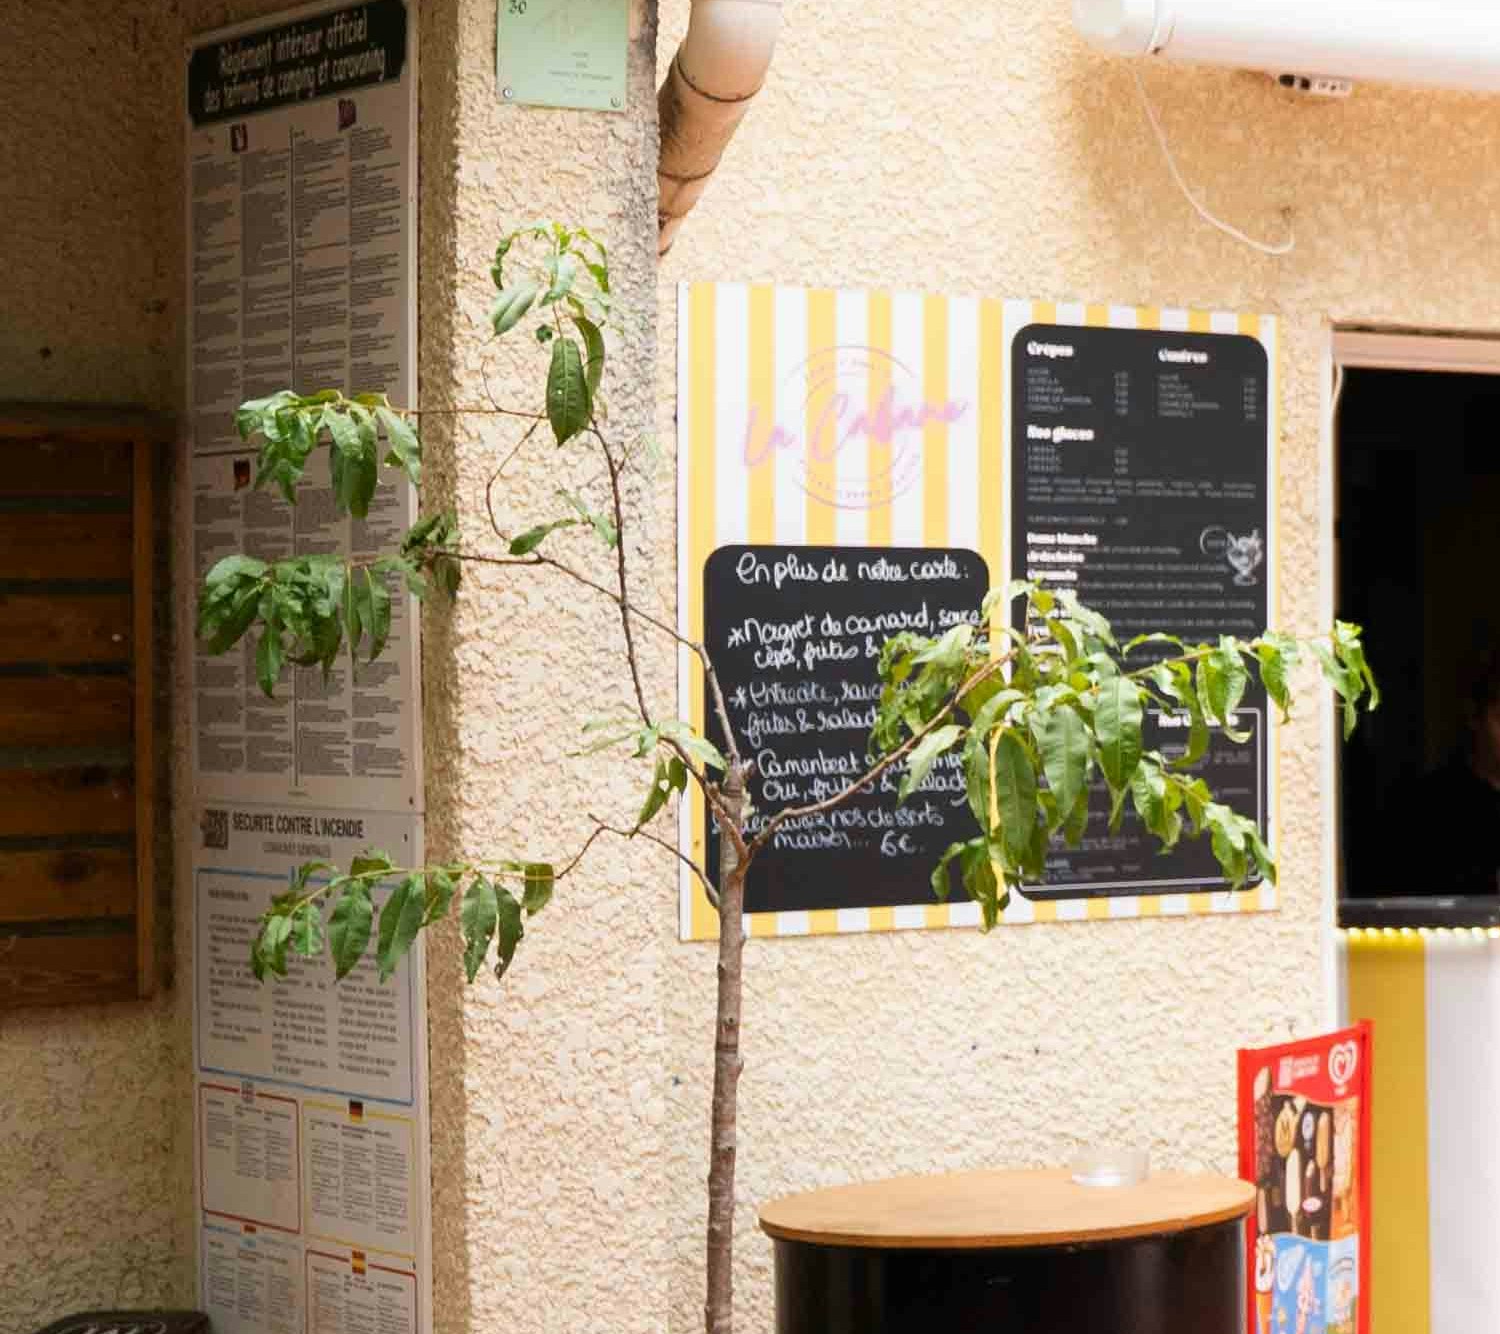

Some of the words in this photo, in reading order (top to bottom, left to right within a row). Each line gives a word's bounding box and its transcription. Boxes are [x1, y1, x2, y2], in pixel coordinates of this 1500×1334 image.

[774, 553, 819, 590] plus
[822, 555, 849, 584] de
[840, 680, 882, 701] sauc
[816, 707, 879, 732] salad
